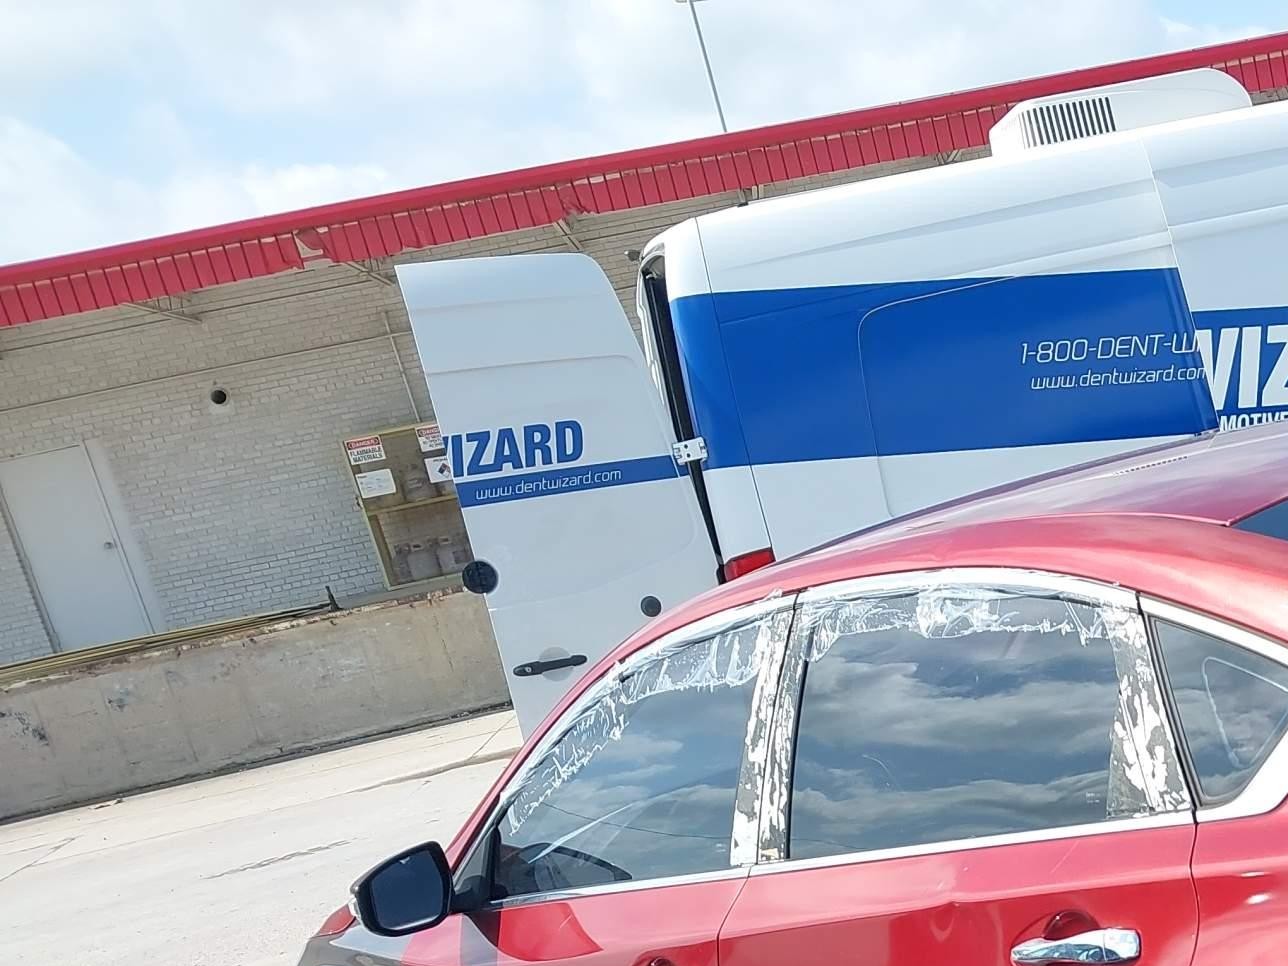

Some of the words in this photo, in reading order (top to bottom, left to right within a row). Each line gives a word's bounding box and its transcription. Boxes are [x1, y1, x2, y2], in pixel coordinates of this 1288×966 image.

[350, 446, 382, 457] FLAMMABLE
[353, 453, 383, 464] MATERIALS
[444, 420, 584, 478] IZARD
[475, 470, 622, 500] www.dentwizard.com
